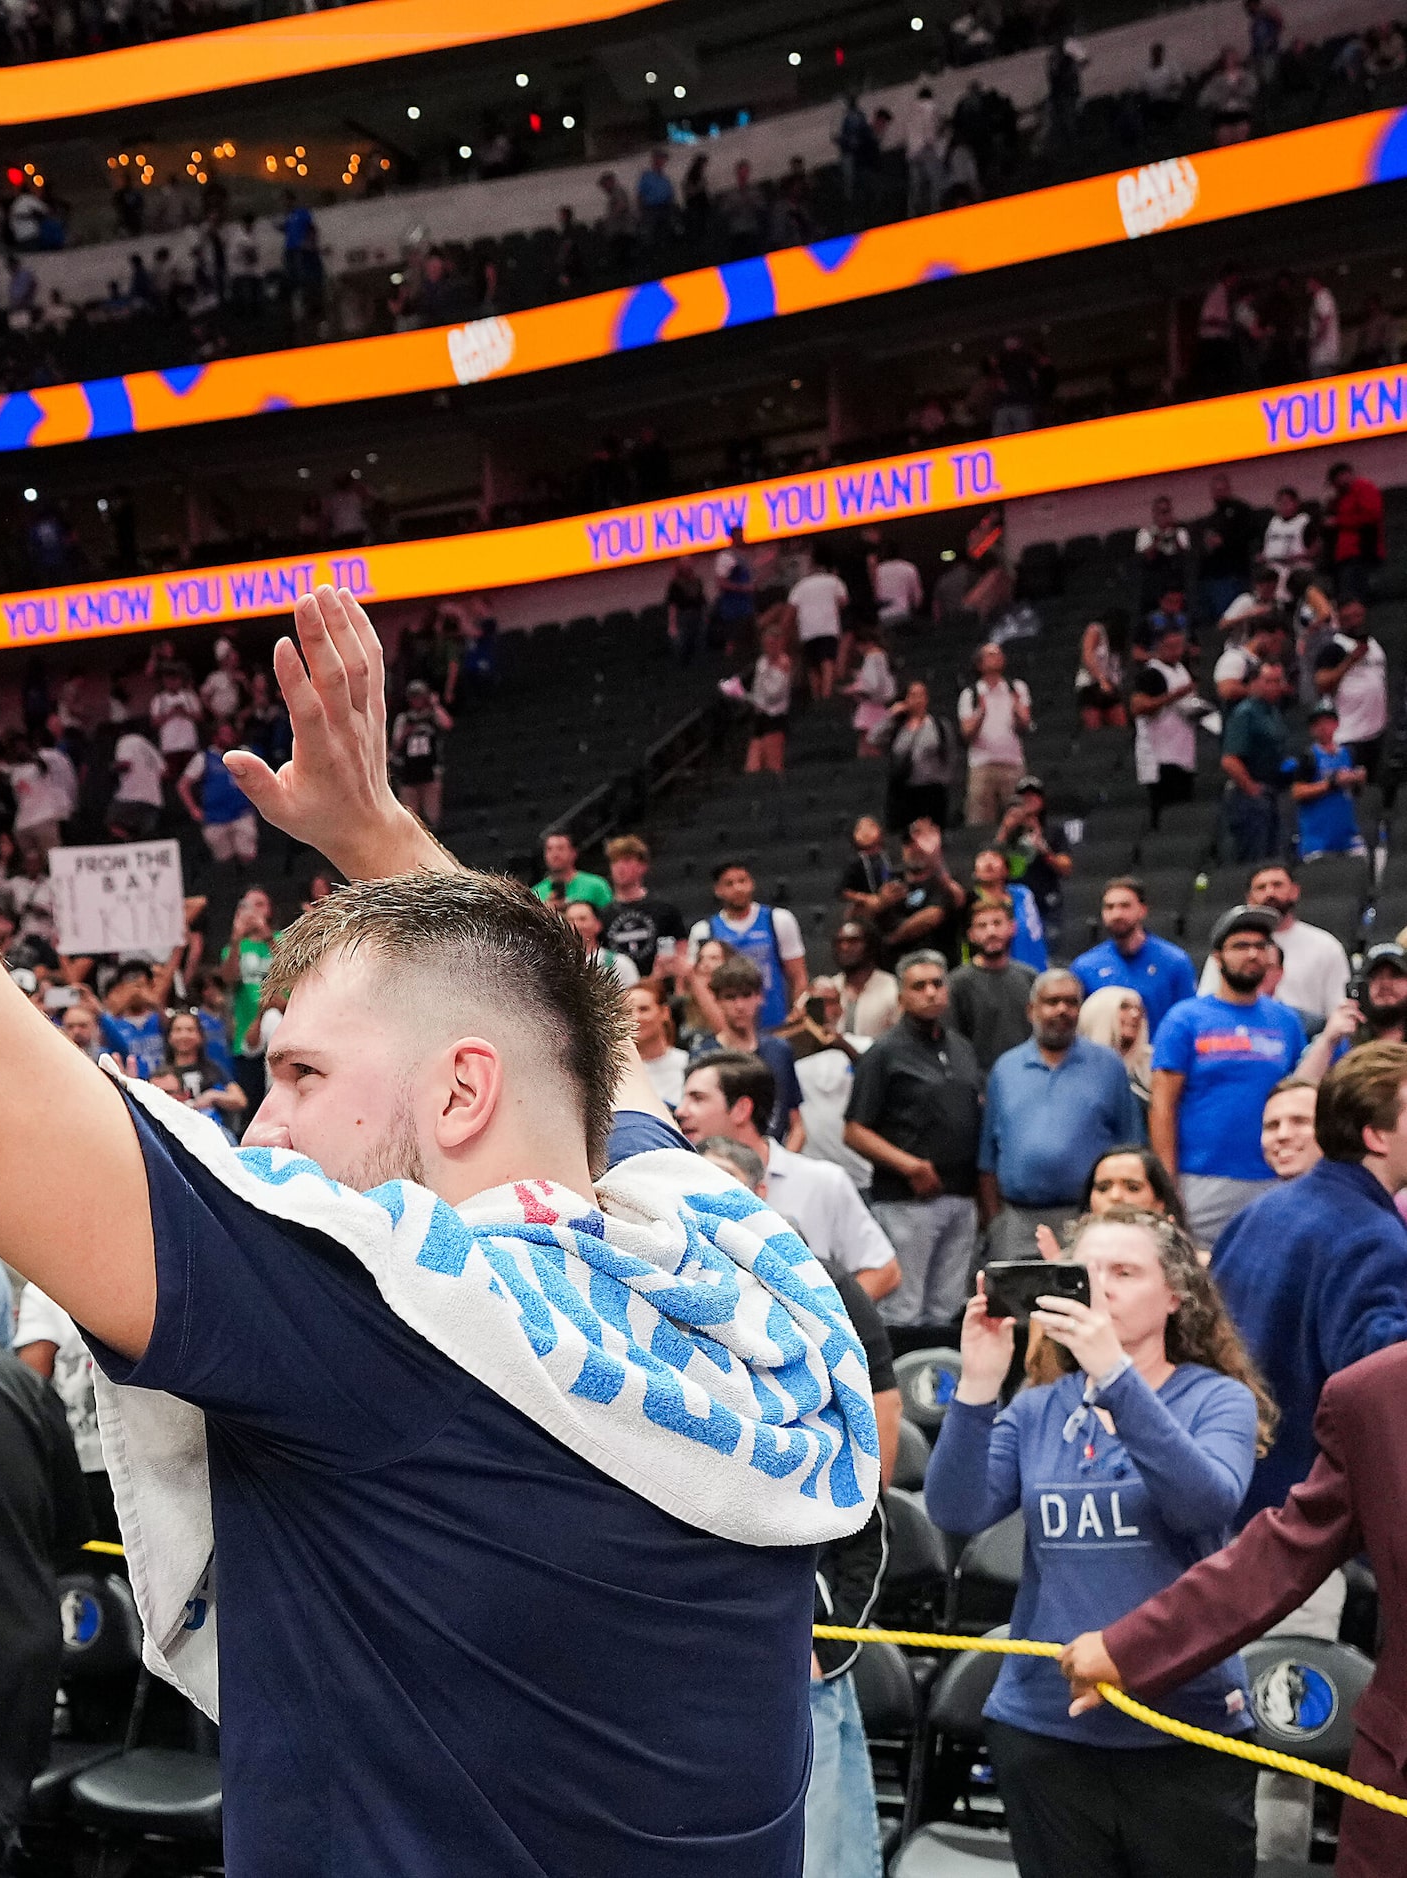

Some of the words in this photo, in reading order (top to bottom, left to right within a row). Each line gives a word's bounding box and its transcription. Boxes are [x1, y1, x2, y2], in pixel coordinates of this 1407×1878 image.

[1262, 389, 1335, 442] YOU
[1350, 377, 1407, 428] KN
[587, 515, 643, 559] YOU
[654, 496, 747, 548] KNOW
[765, 481, 825, 527] YOU
[837, 462, 932, 515] WANT
[951, 451, 1000, 496] TO.
[4, 598, 57, 636] YOU
[67, 587, 150, 628] KNOW
[166, 577, 221, 616] YOU
[229, 564, 314, 608] WANT
[331, 558, 374, 595] TO.
[75, 853, 128, 873] FROM
[136, 850, 170, 868] THE
[1039, 1491, 1141, 1538] DAL
